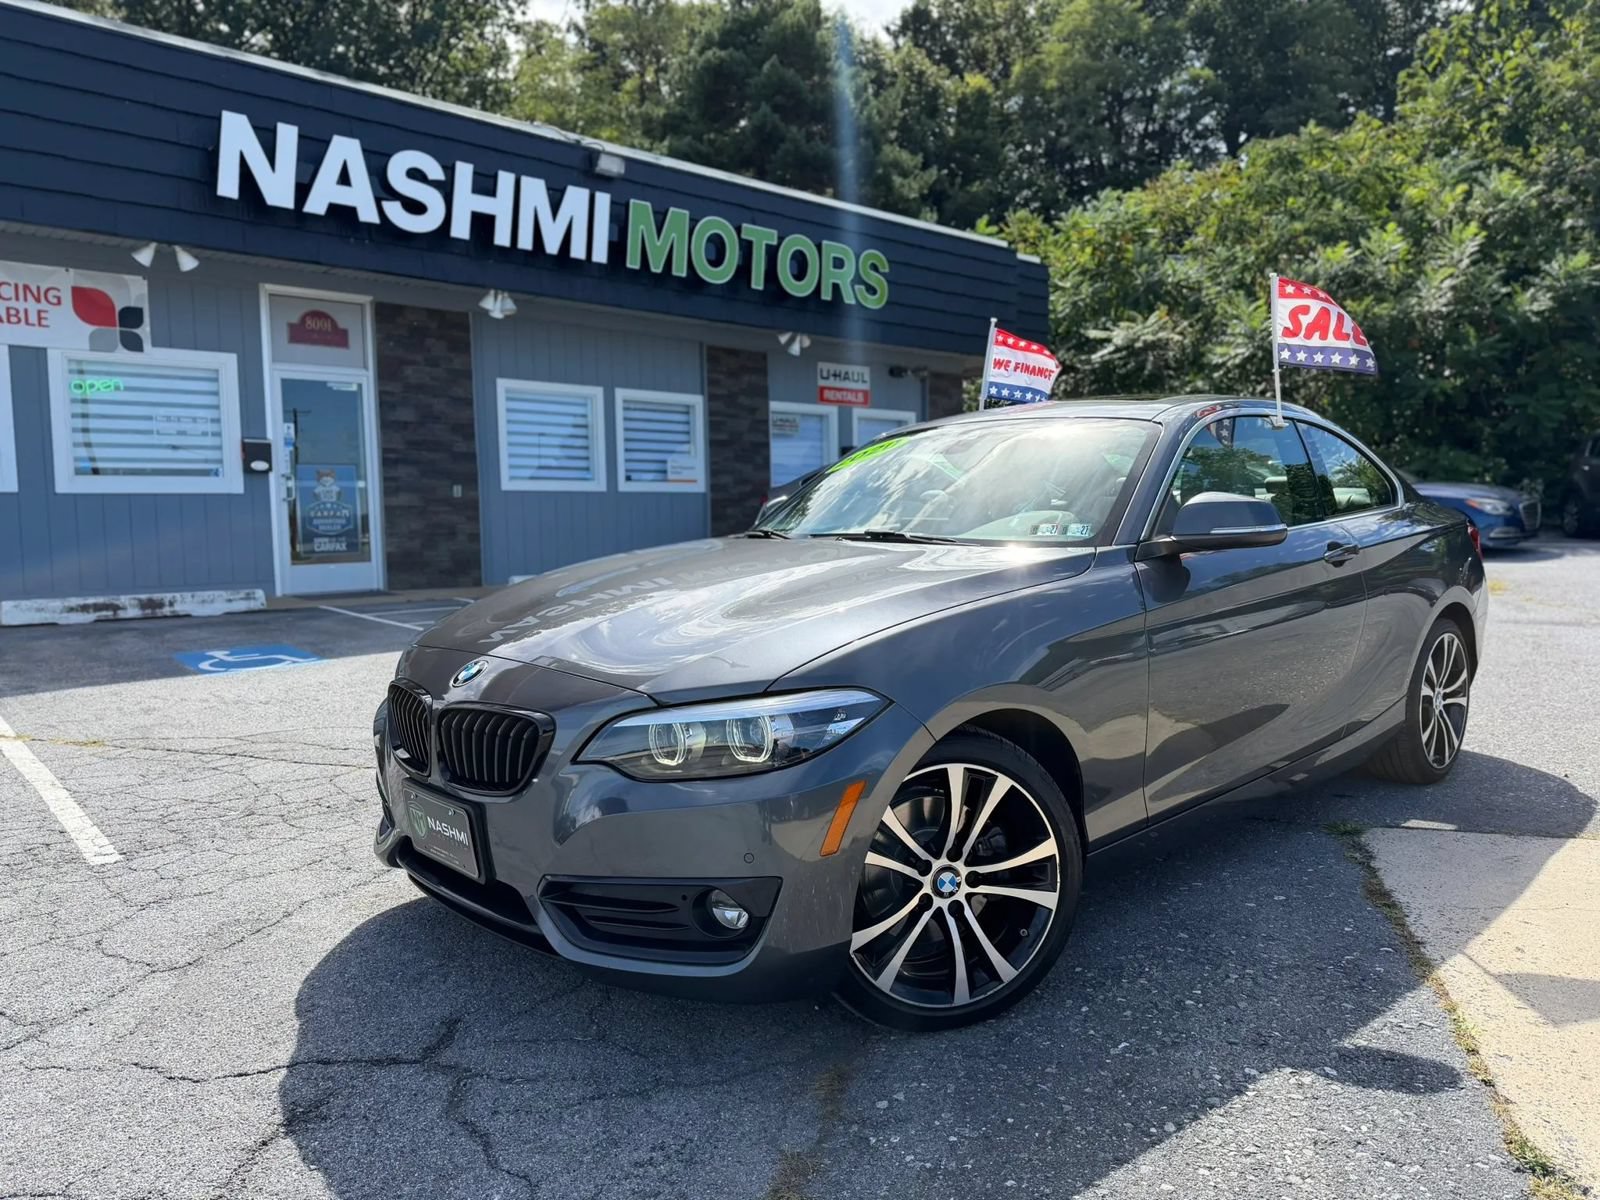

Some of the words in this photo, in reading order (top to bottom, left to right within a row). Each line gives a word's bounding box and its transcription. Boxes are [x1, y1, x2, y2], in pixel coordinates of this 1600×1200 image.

[216, 110, 611, 265] NASHMI
[626, 199, 889, 310] MOTORS
[0, 306, 51, 328] BLE
[993, 357, 1011, 372] WE
[1013, 361, 1054, 381] FINANCE
[70, 378, 124, 396] open
[823, 389, 865, 403] RENTALS
[426, 815, 469, 847] NASHMI
